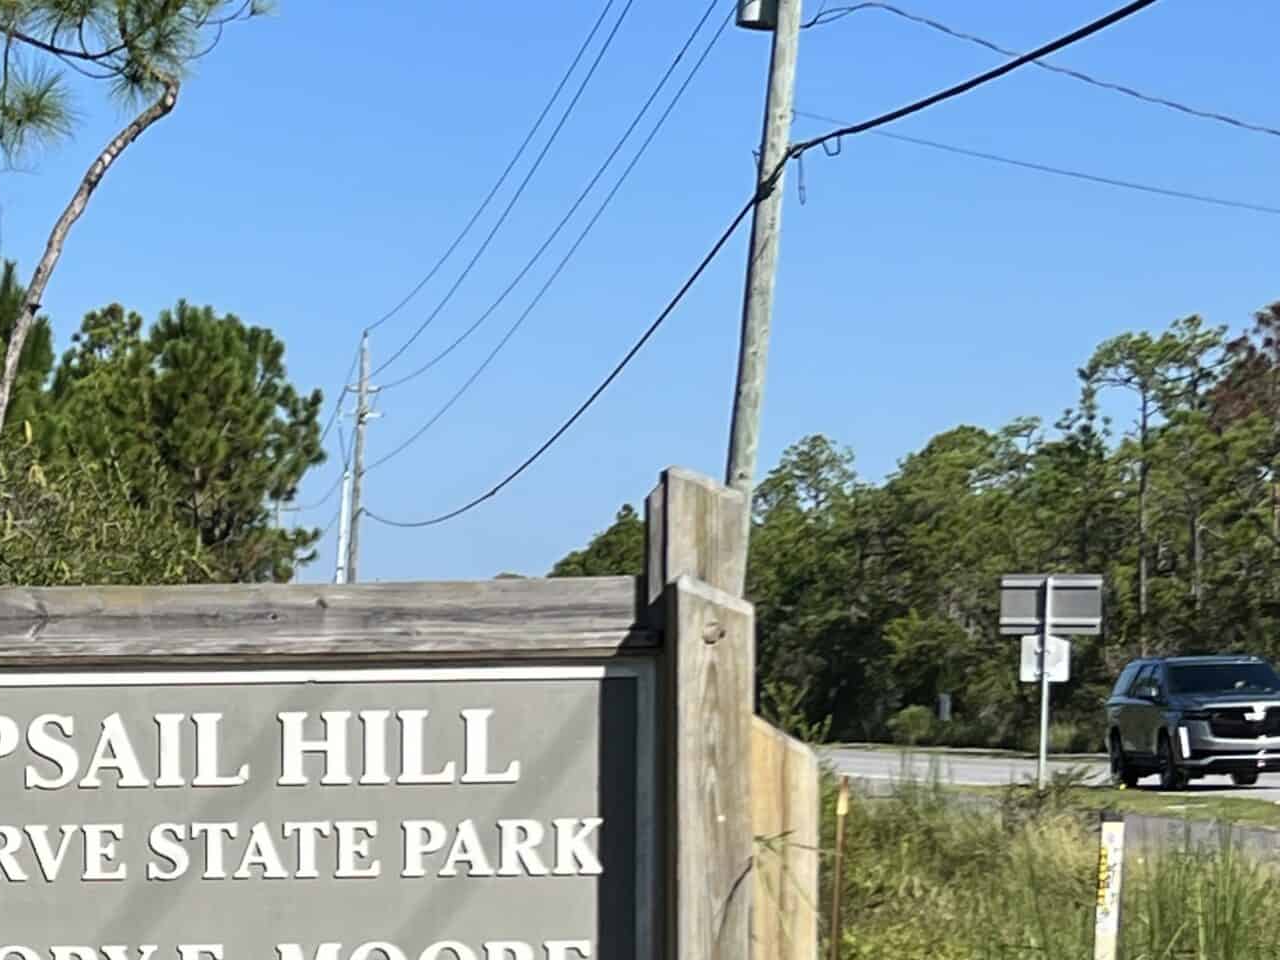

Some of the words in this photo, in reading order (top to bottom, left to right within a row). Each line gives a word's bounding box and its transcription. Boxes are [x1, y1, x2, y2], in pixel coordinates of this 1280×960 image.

[278, 708, 522, 786] HILL
[148, 820, 382, 881] STATE
[401, 817, 604, 878] PARK
